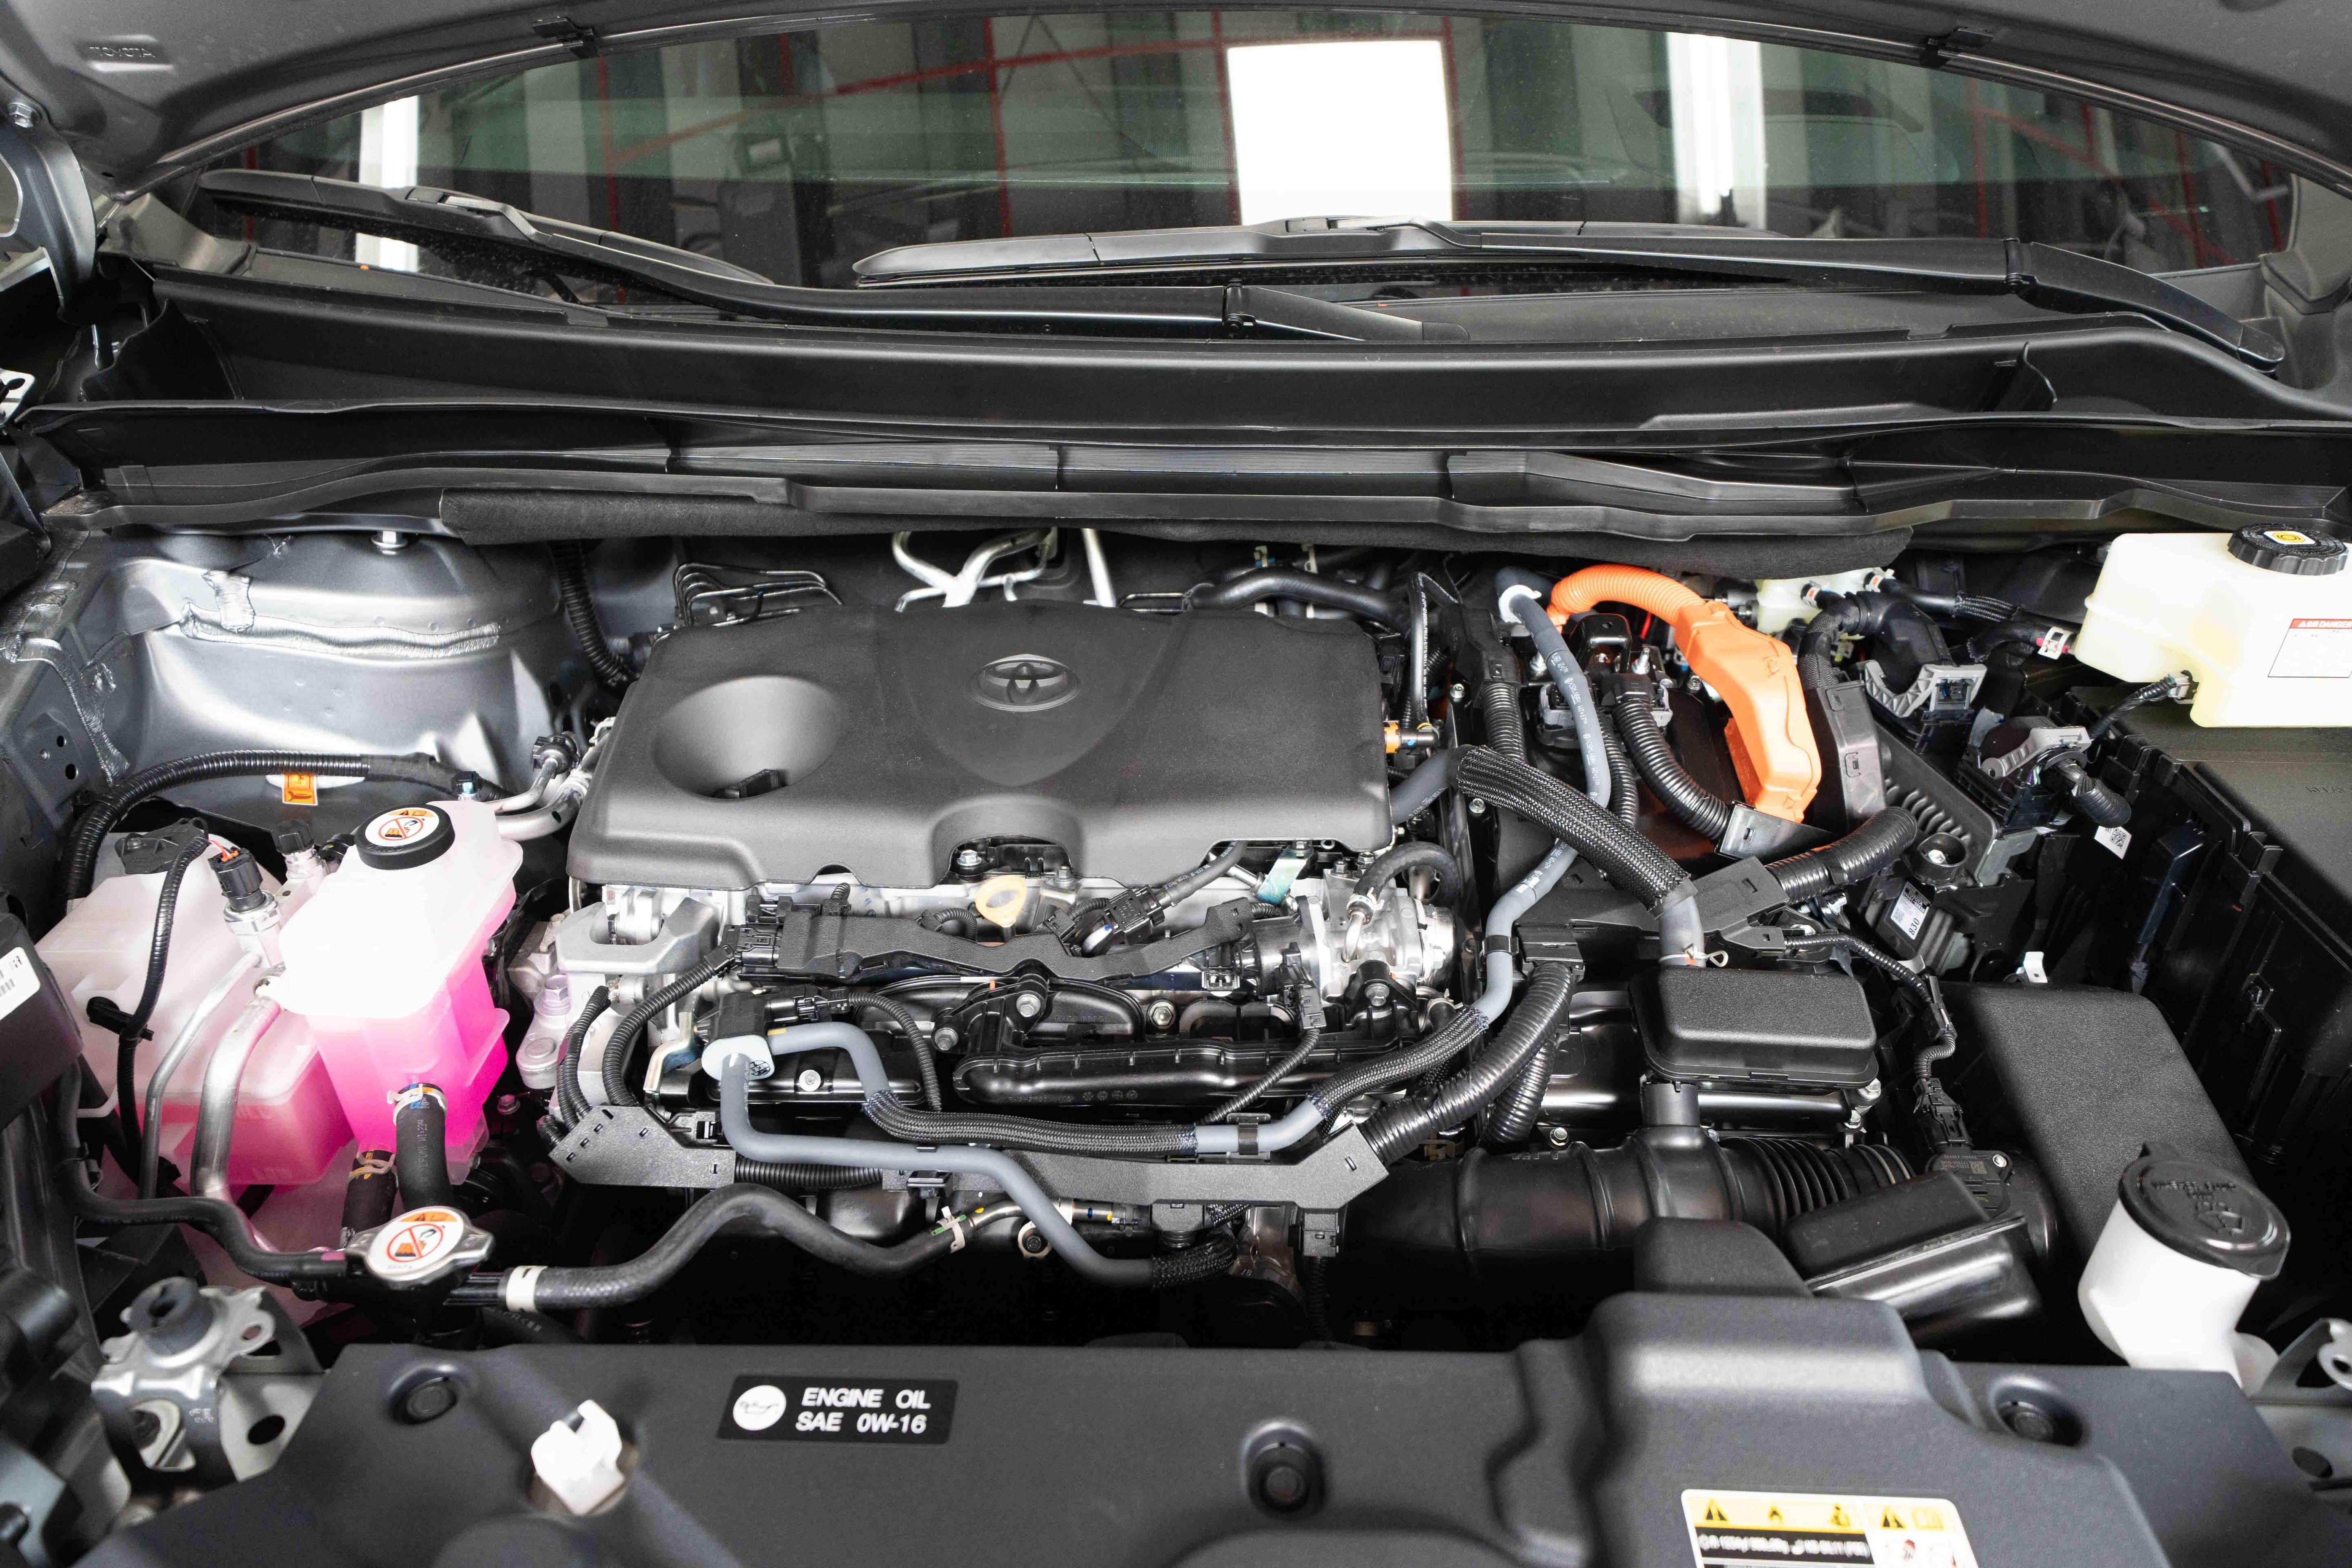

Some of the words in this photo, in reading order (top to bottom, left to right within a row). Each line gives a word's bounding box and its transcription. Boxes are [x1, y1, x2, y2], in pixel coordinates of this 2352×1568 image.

[89, 46, 156, 58] TOYOTA
[1909, 918, 1920, 935] 830
[801, 1387, 884, 1408] ENGINE
[895, 1389, 931, 1410] OIL
[795, 1411, 844, 1432] SAE
[856, 1414, 927, 1434] 0W-16
